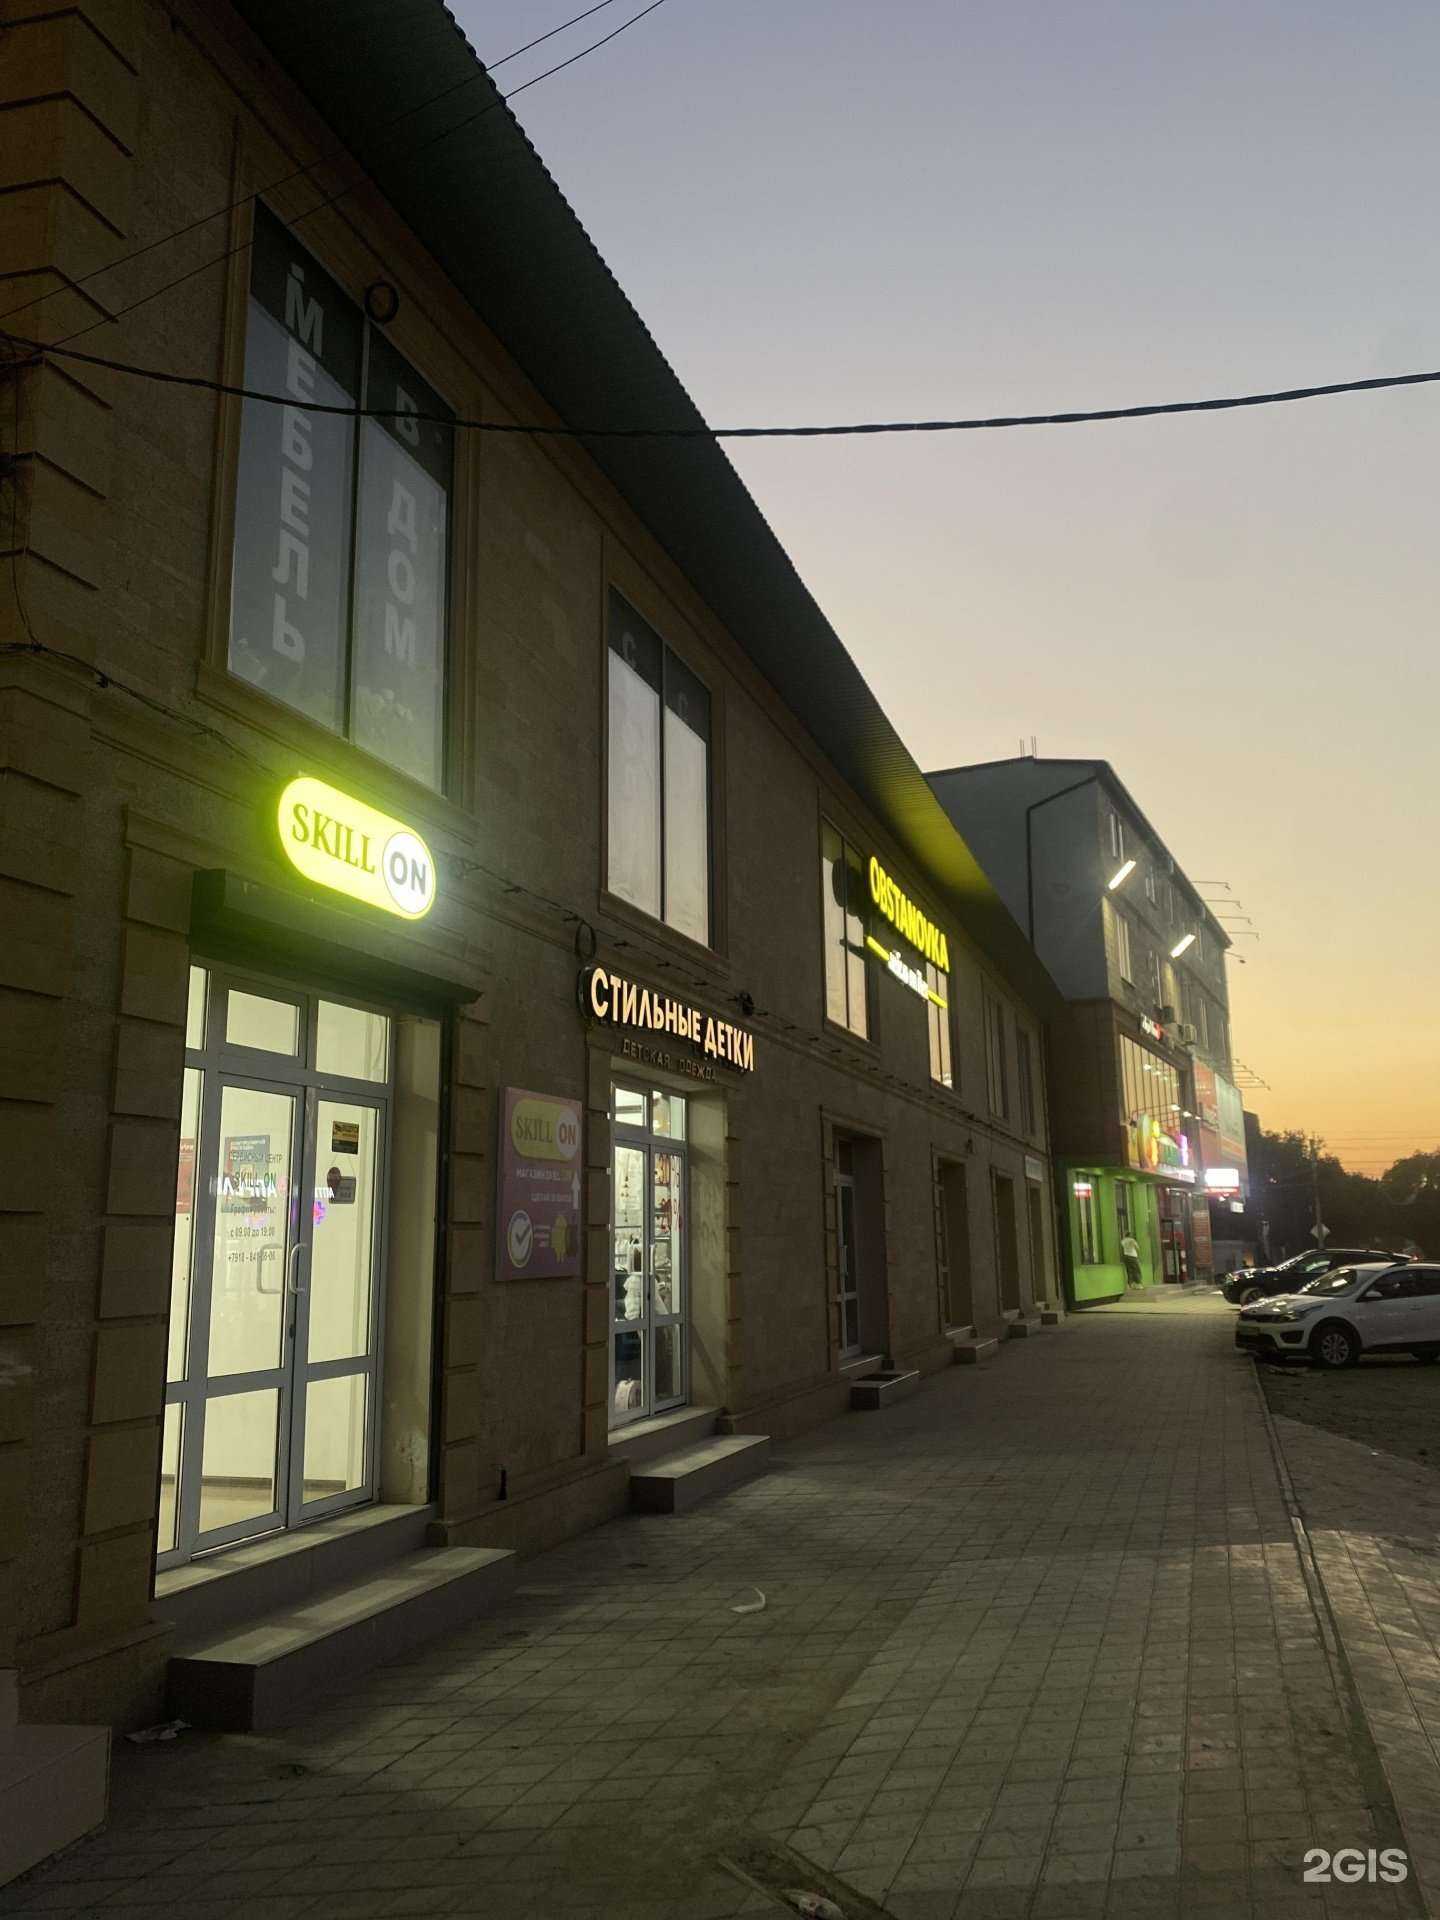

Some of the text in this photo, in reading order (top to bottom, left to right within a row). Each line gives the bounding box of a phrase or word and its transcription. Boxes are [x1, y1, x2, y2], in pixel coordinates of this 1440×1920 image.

[271, 263, 323, 663] МЕБЕЛЬ
[384, 480, 418, 668] ДОМ
[292, 803, 427, 896] SKILL ON
[869, 855, 950, 974] OBSTANOVKA
[591, 967, 754, 1072] СТИЛЬНЫЕ ДЕТКИ
[622, 1038, 671, 1069] ДЕТСКАЯ
[234, 1170, 260, 1189] SKILL
[263, 1171, 277, 1189] ON
[515, 1115, 576, 1146] SKILL ON
